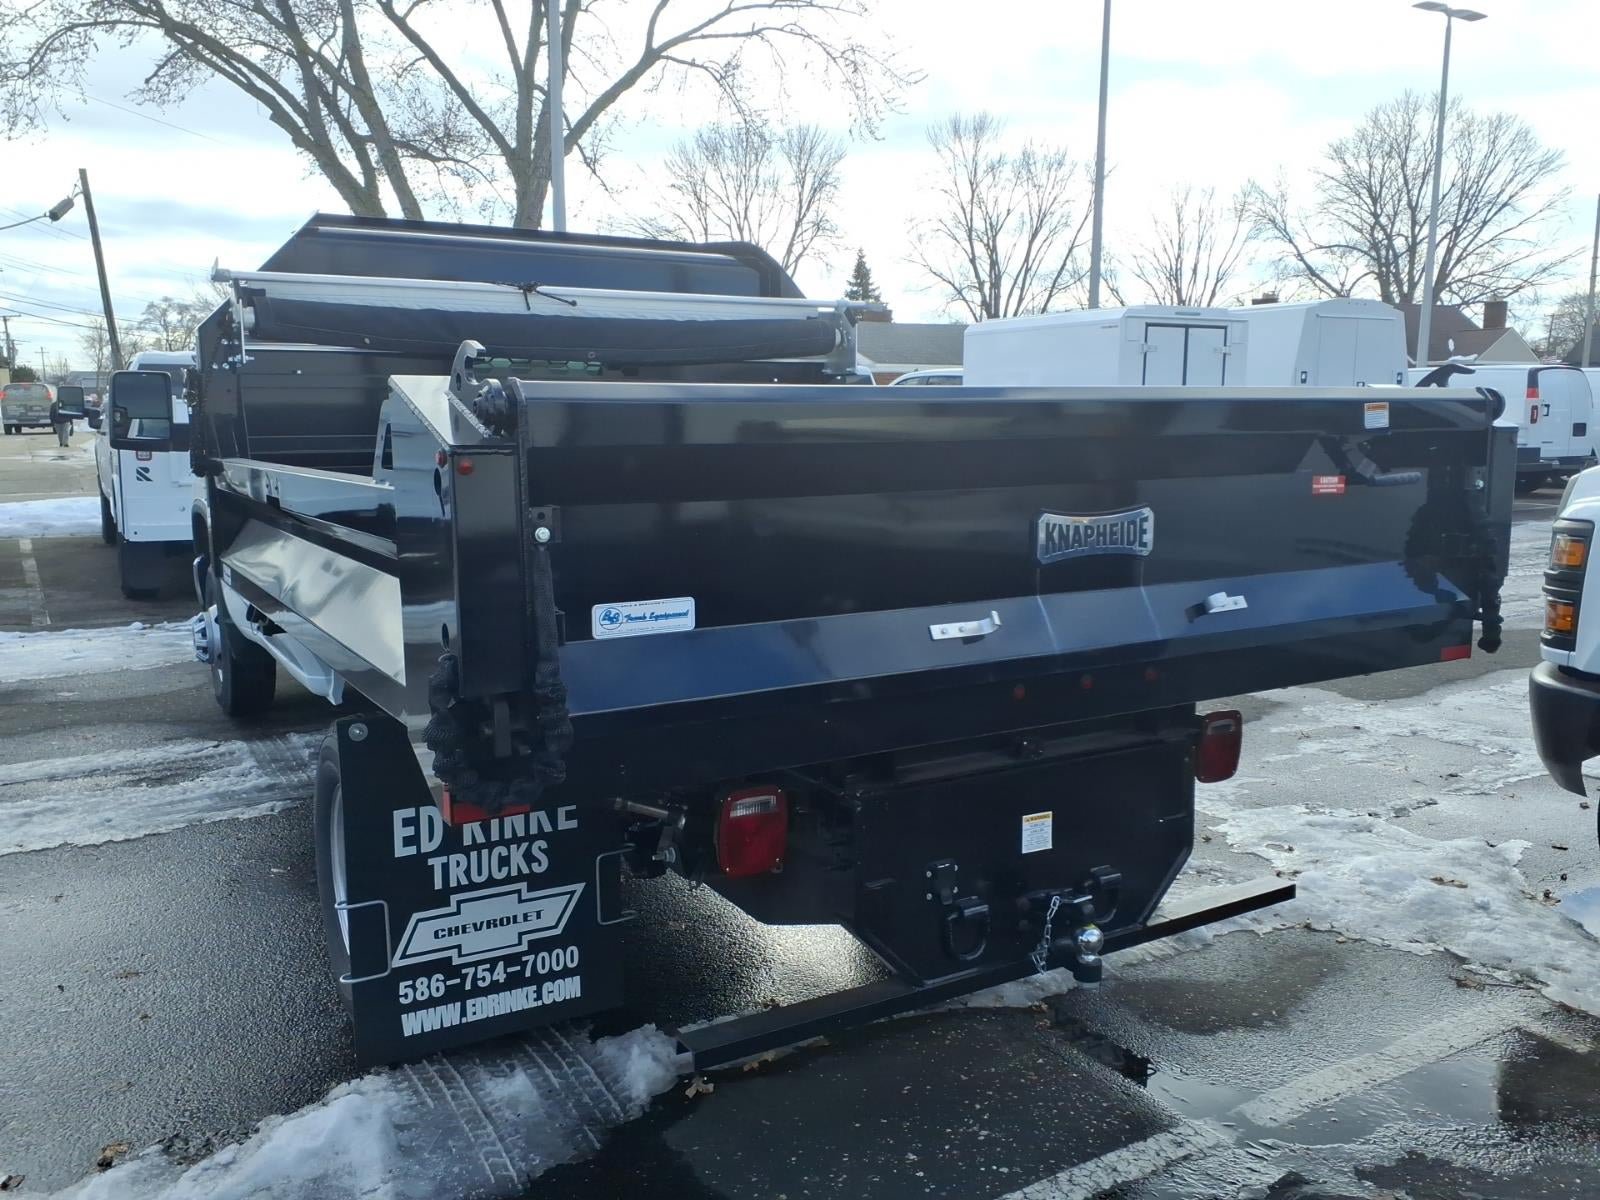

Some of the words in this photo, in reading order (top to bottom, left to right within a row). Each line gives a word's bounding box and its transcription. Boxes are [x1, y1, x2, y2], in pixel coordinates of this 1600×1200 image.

[1044, 516, 1149, 554] KNAPHEIDE
[393, 805, 443, 857] ED
[427, 839, 549, 890] TRUCKS
[433, 909, 544, 940] CHEVROLET
[398, 945, 579, 1004] 586-754-7000
[401, 975, 581, 1037] WWW.EDRINKE.COM
